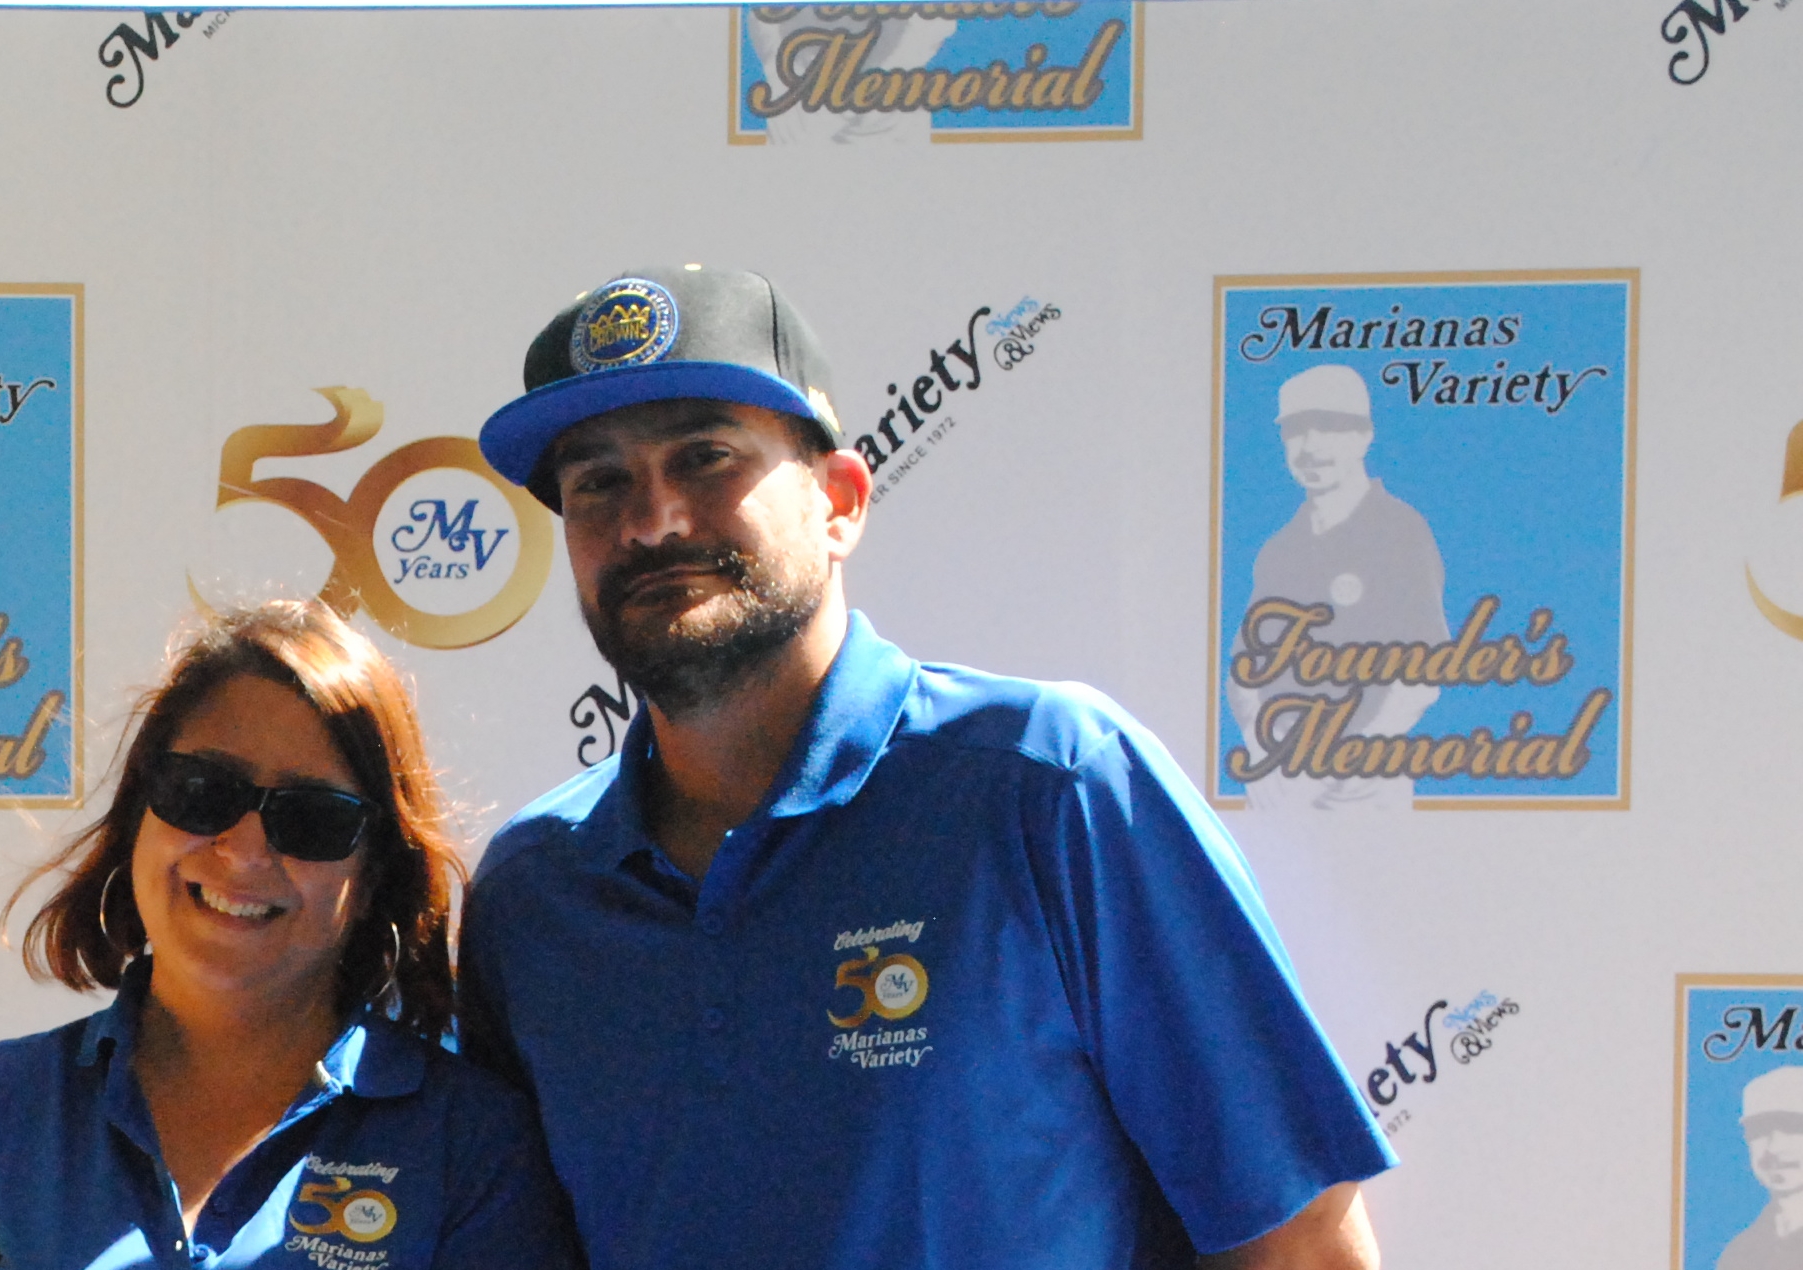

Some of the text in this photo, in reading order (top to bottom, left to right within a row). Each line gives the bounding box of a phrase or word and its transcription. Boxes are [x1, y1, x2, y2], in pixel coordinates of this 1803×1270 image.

[748, 17, 1126, 118] Memorial
[985, 295, 1040, 336] News
[1010, 303, 1062, 341] Views
[1241, 304, 1520, 362] Marianas
[853, 306, 991, 475] ariety
[1382, 361, 1607, 413] Variety
[887, 416, 957, 485] SINCE 1972
[393, 555, 470, 584] years
[1231, 595, 1574, 689] Founder's
[1227, 689, 1613, 782] Memorial
[834, 919, 925, 950] Celebrating
[826, 946, 929, 1028] 50
[828, 1027, 928, 1059] Marianas
[850, 1045, 934, 1069] Variety
[1383, 1109, 1412, 1137] 972
[305, 1151, 399, 1184] Celebrating
[288, 1176, 398, 1243] 50
[285, 1235, 388, 1261] Marianas
